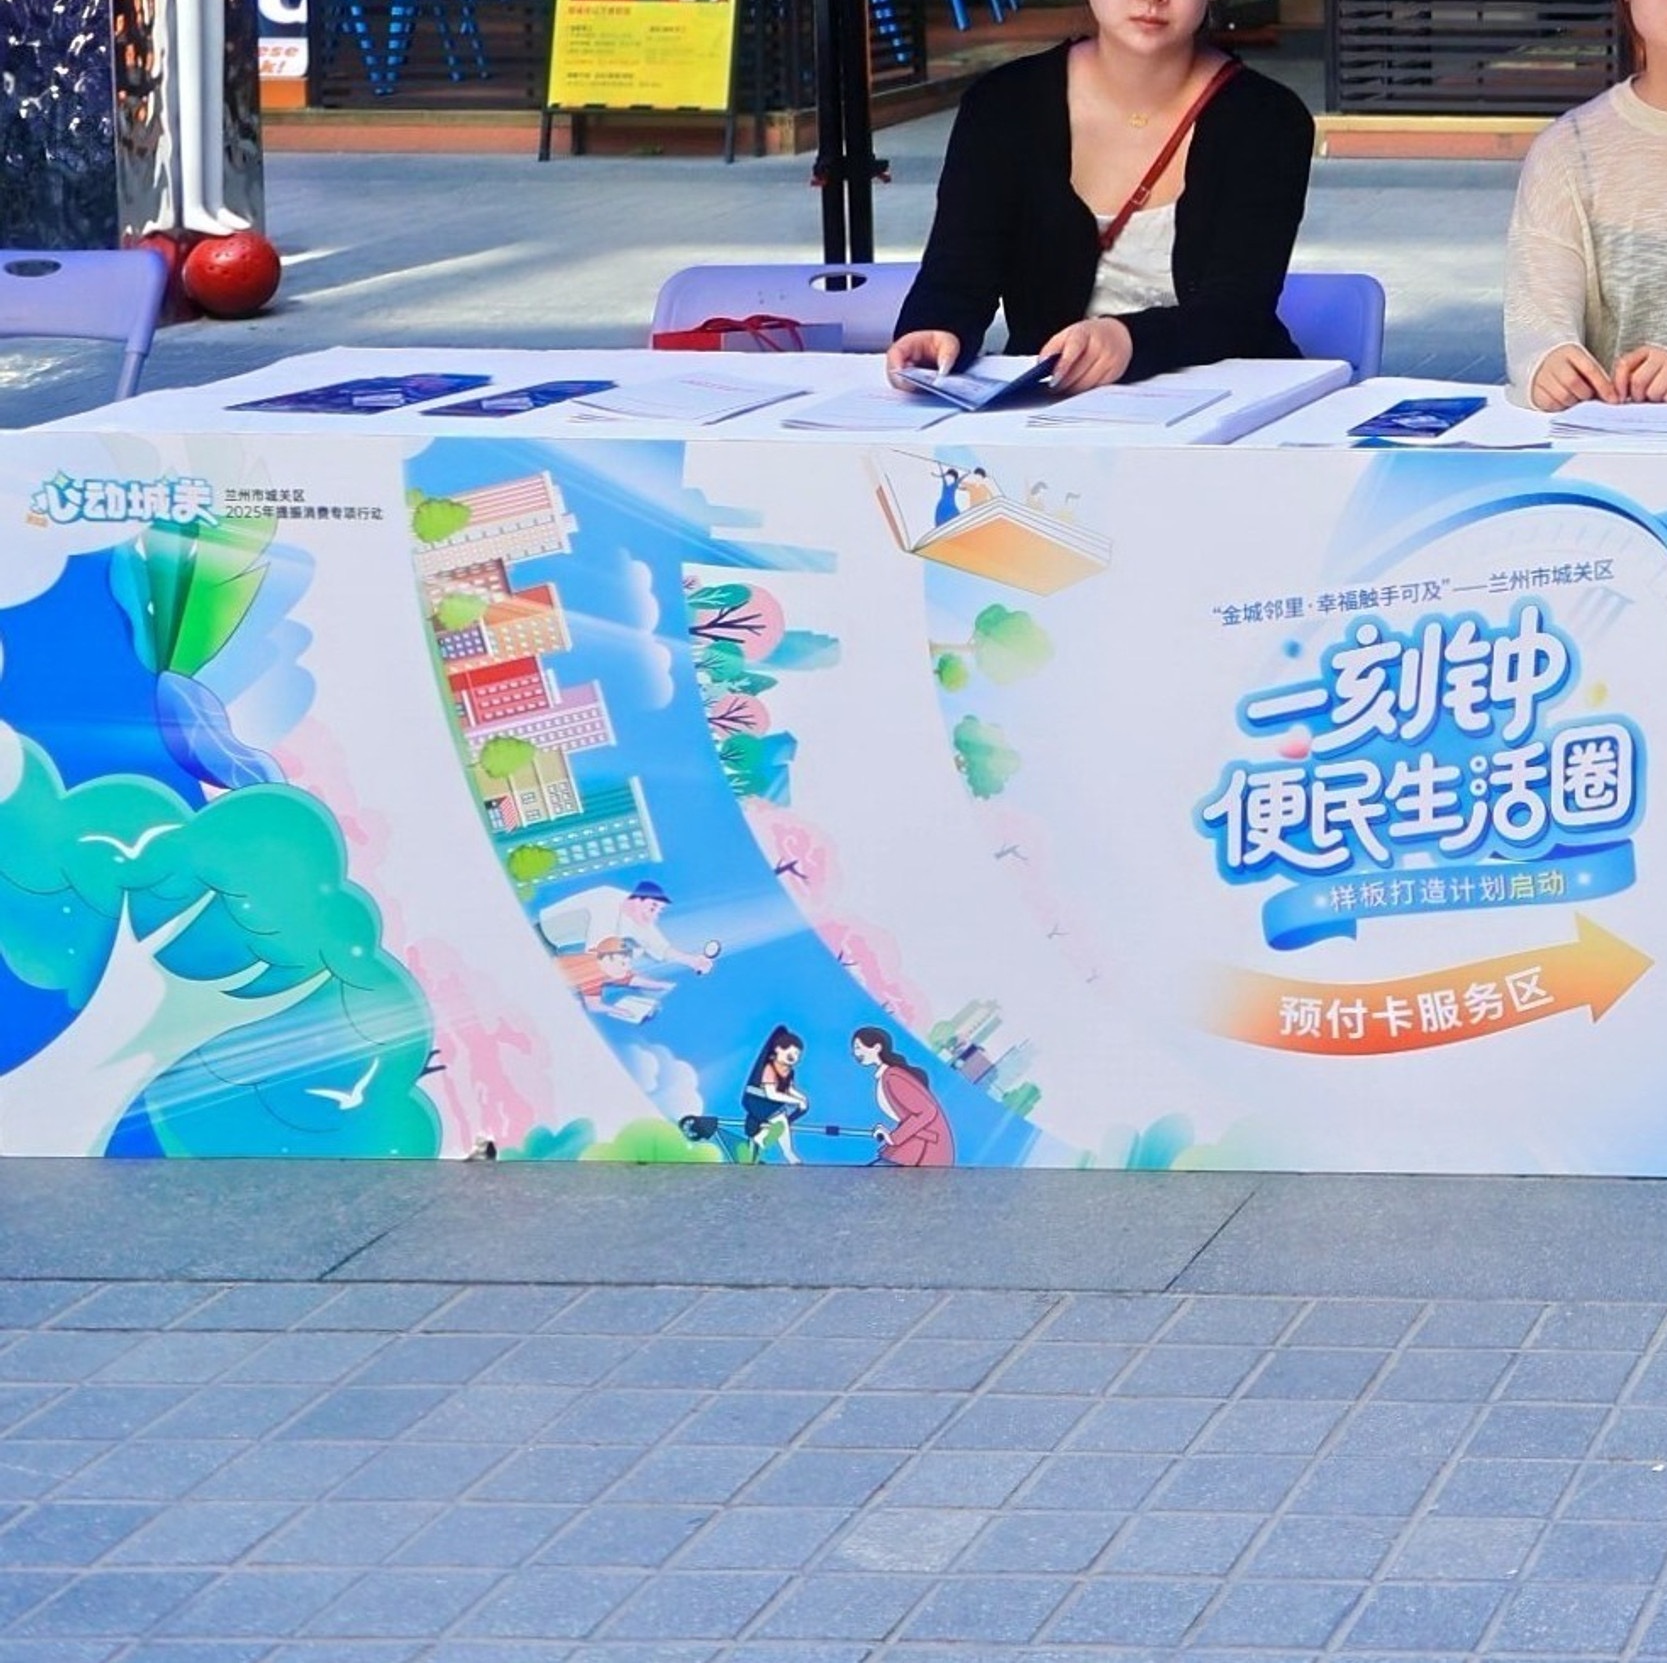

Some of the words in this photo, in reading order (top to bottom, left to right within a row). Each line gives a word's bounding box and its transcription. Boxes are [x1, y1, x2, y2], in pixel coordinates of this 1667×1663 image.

[29, 468, 219, 527] 心动城关
[225, 489, 305, 503] 兰州市城关区
[225, 505, 384, 521] 2025年提振消费专项行动
[1246, 603, 1571, 754] 一刻钟
[1203, 724, 1635, 869] 便民生活圈
[1330, 870, 1567, 911] 样板打造计划启动
[1277, 965, 1554, 1040] 预付卡服务区
